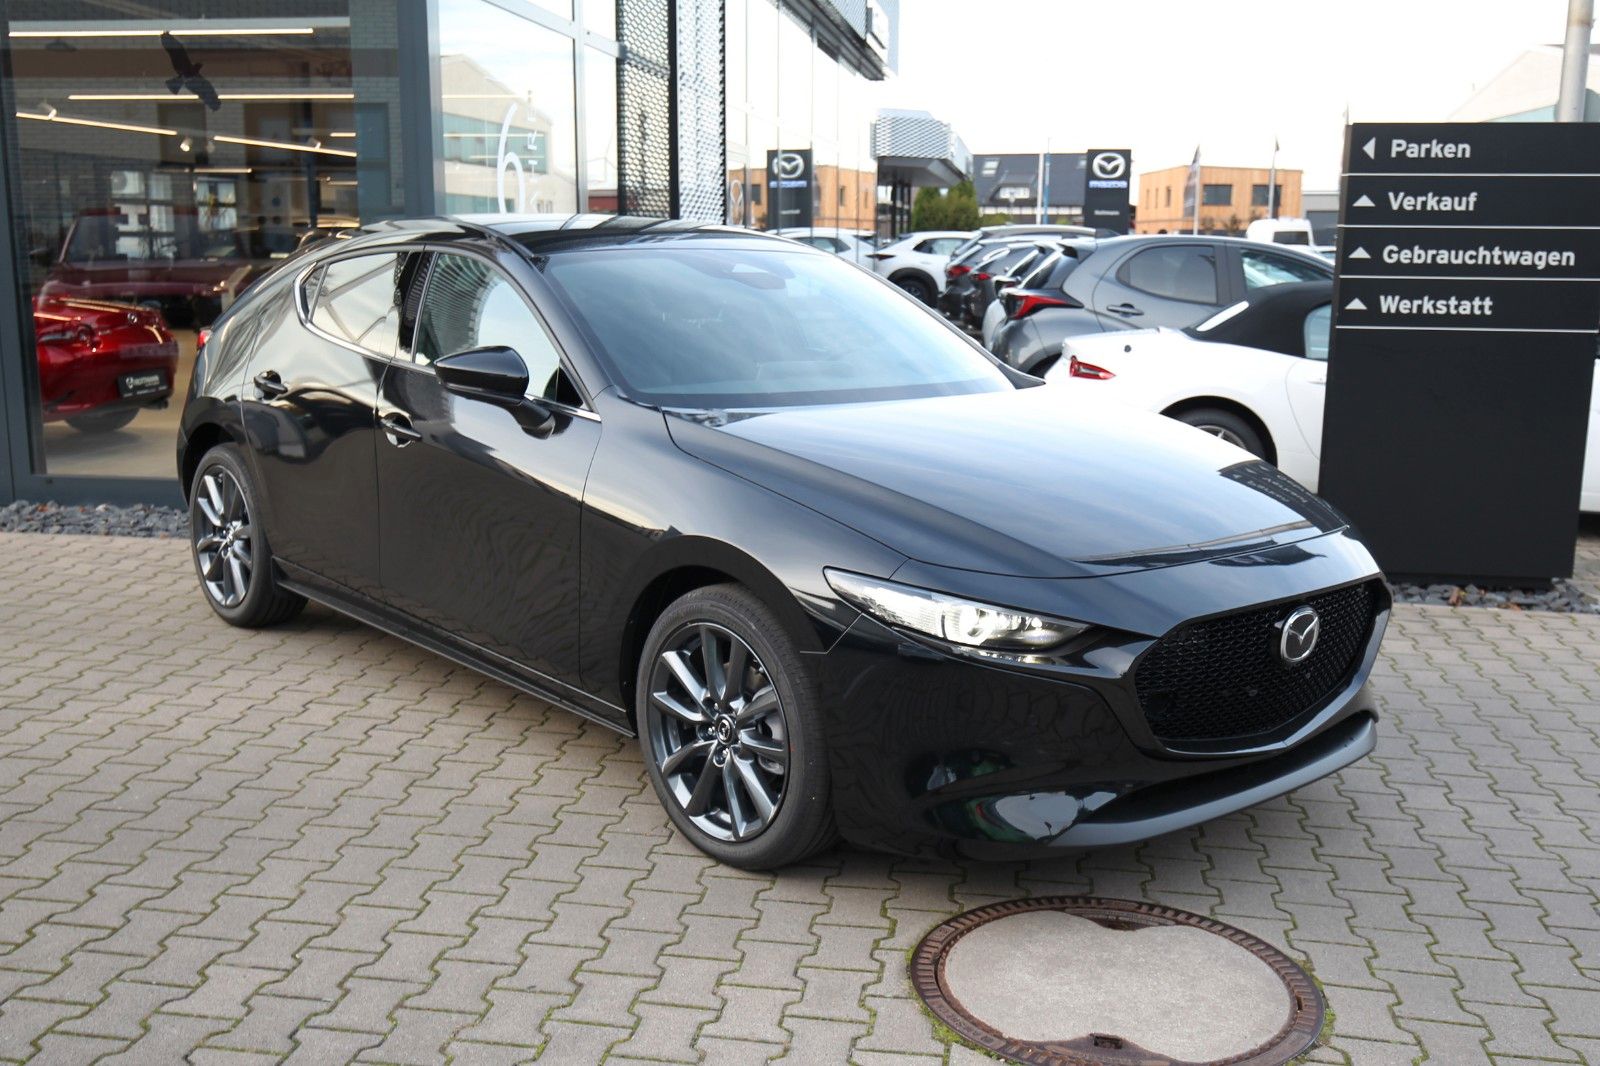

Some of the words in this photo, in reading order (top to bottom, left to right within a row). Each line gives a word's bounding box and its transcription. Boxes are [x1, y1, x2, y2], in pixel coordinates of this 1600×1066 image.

[1390, 138, 1472, 159] Parken
[1388, 191, 1478, 212] Verkauf
[1382, 244, 1576, 270] Gebrauchtwagen
[1379, 295, 1493, 316] Werkstatt
